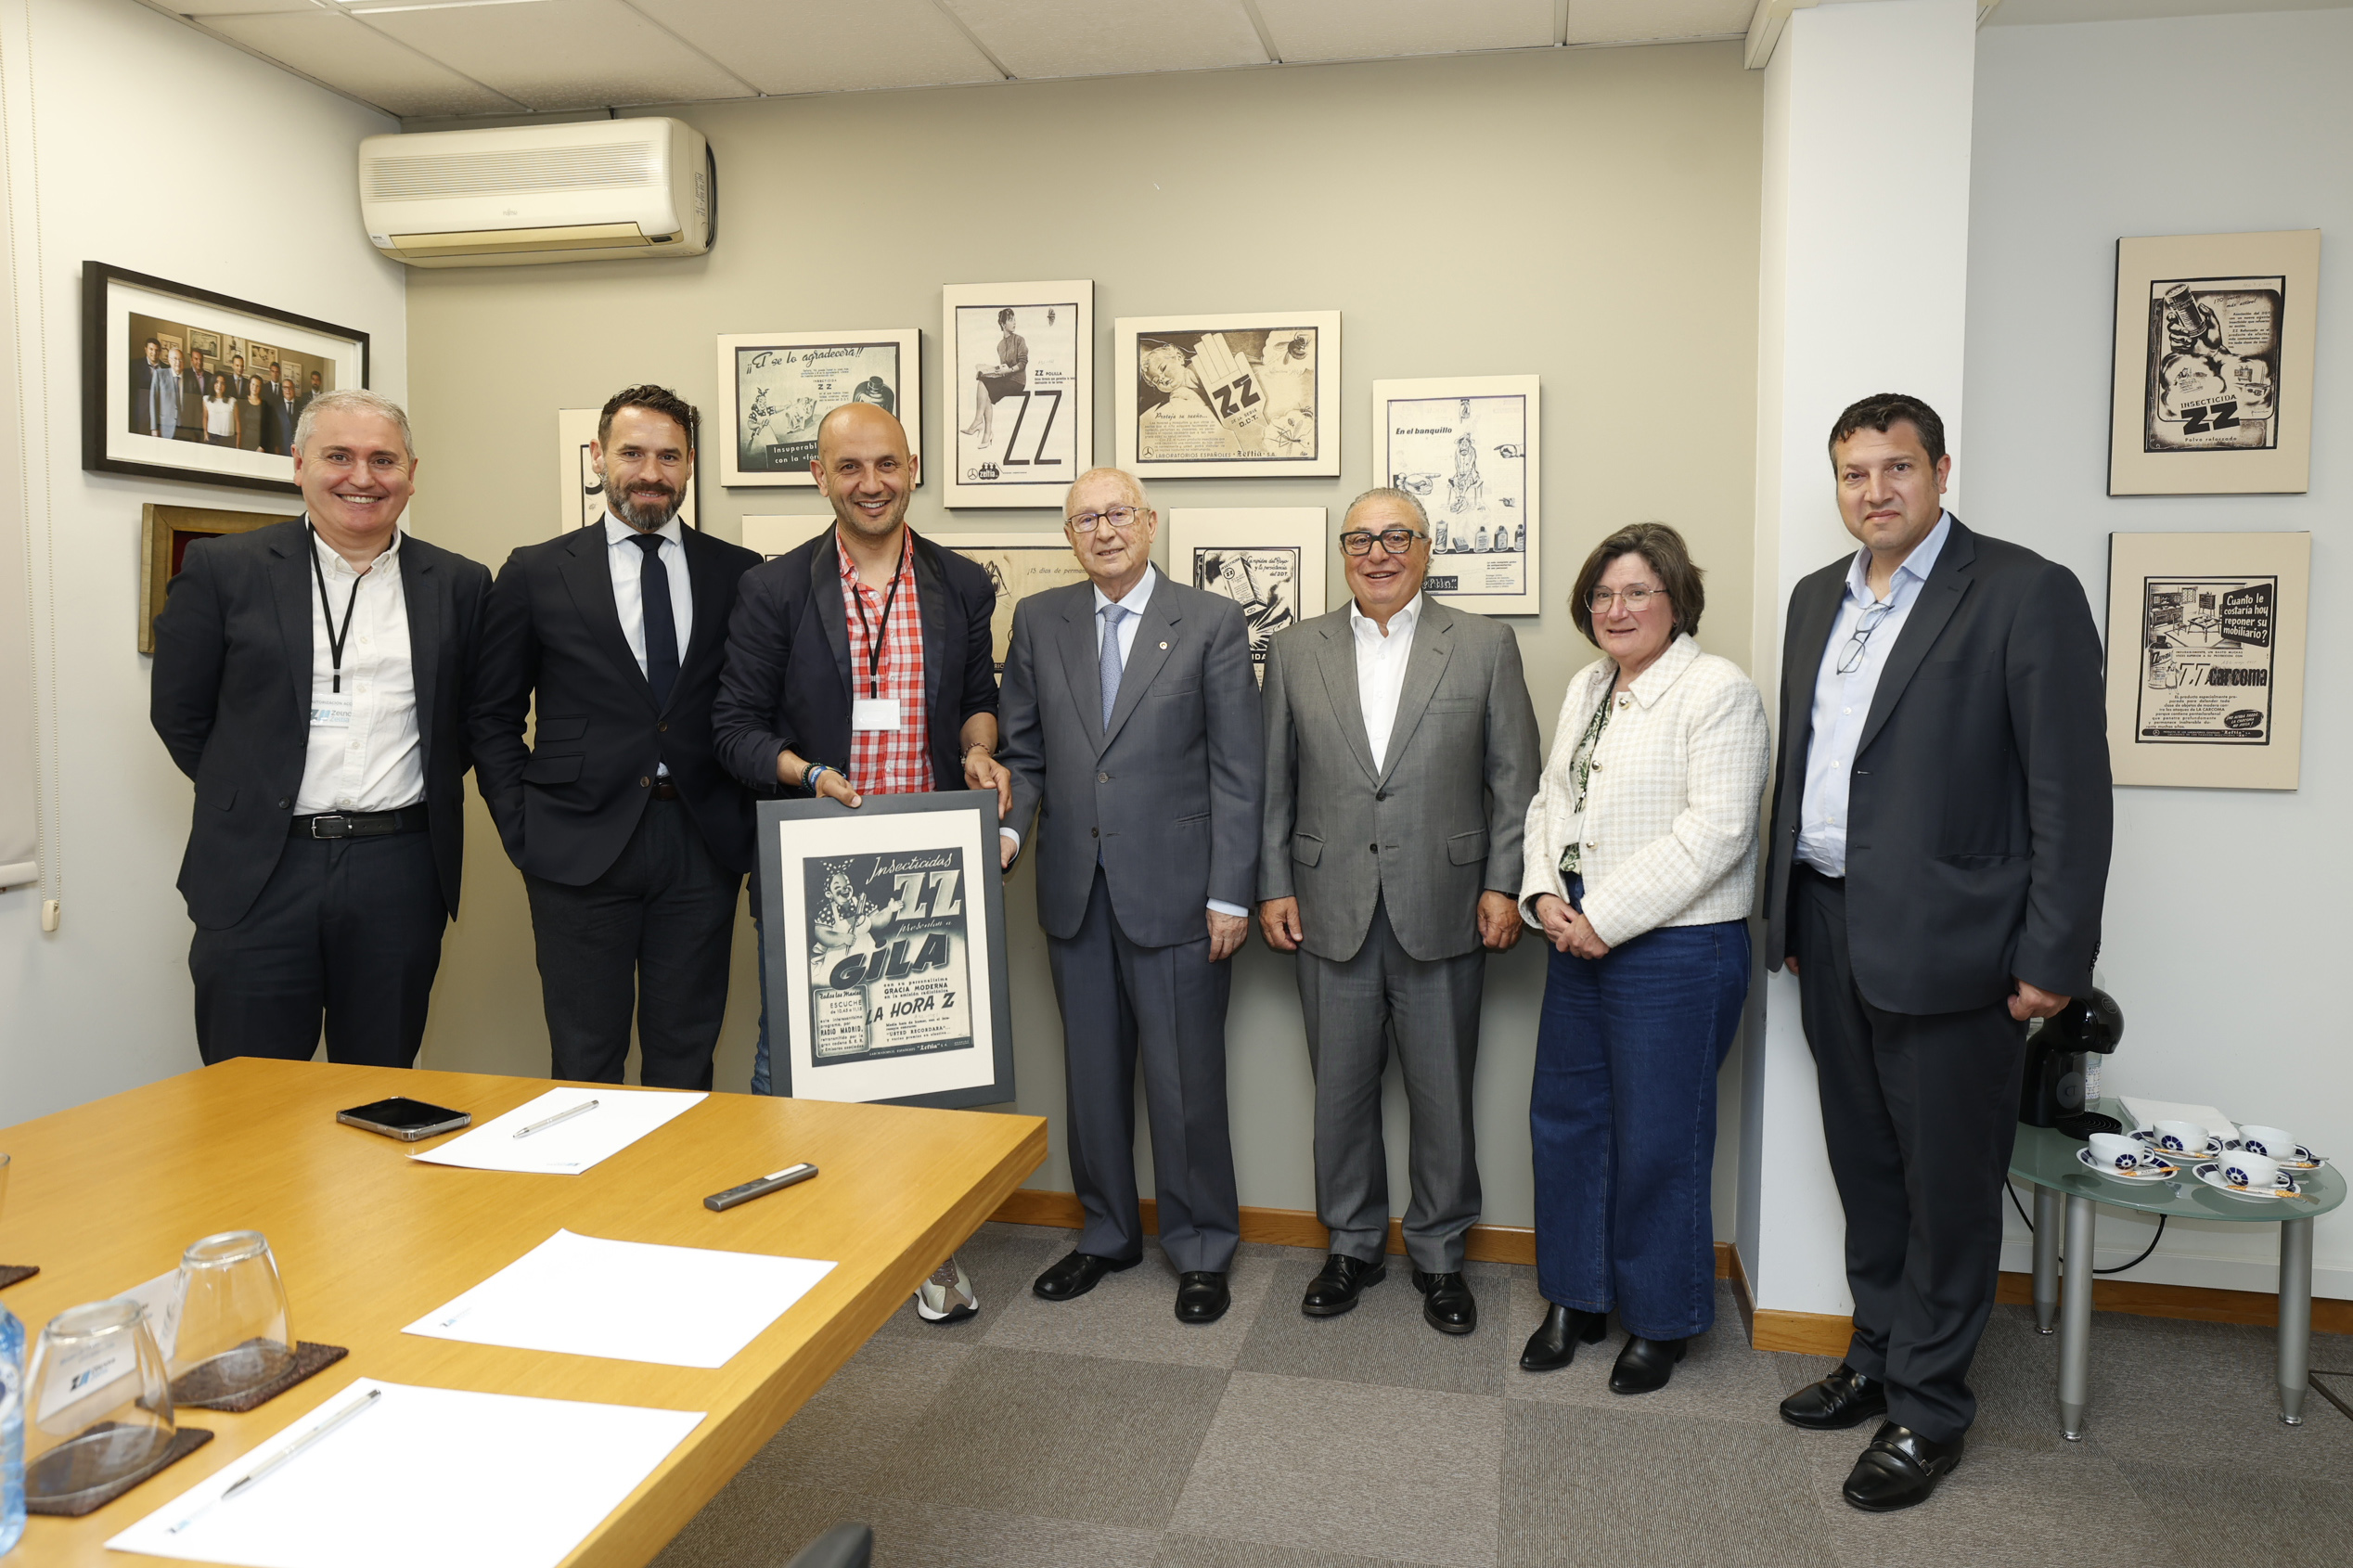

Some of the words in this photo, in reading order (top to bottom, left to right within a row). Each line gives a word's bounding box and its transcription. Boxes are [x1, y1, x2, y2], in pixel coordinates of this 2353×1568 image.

[787, 352, 797, 364] lo
[1212, 374, 1261, 418] ZZ
[2180, 394, 2237, 408] INSECTICIDA
[2180, 401, 2241, 435] ZZ
[1415, 427, 1452, 435] banquillo
[774, 442, 817, 453] Insuperabl
[2227, 594, 2253, 606] Cuanto
[2257, 593, 2264, 603] le
[2224, 605, 2253, 615] costaría
[2255, 605, 2269, 617] hoy
[2224, 618, 2256, 626] reponer
[2257, 619, 2267, 627] su
[2223, 625, 2268, 643] mobiliario?
[866, 853, 953, 885] Insecticidas
[894, 869, 961, 921] ZZ
[884, 986, 909, 995] GRACIA
[914, 983, 947, 991] MODERNA
[830, 999, 862, 1009] ESCUCHE
[865, 1007, 883, 1025] LA
[890, 996, 934, 1018] HORA
[941, 992, 956, 1009] Z
[820, 1028, 836, 1036] RADIO
